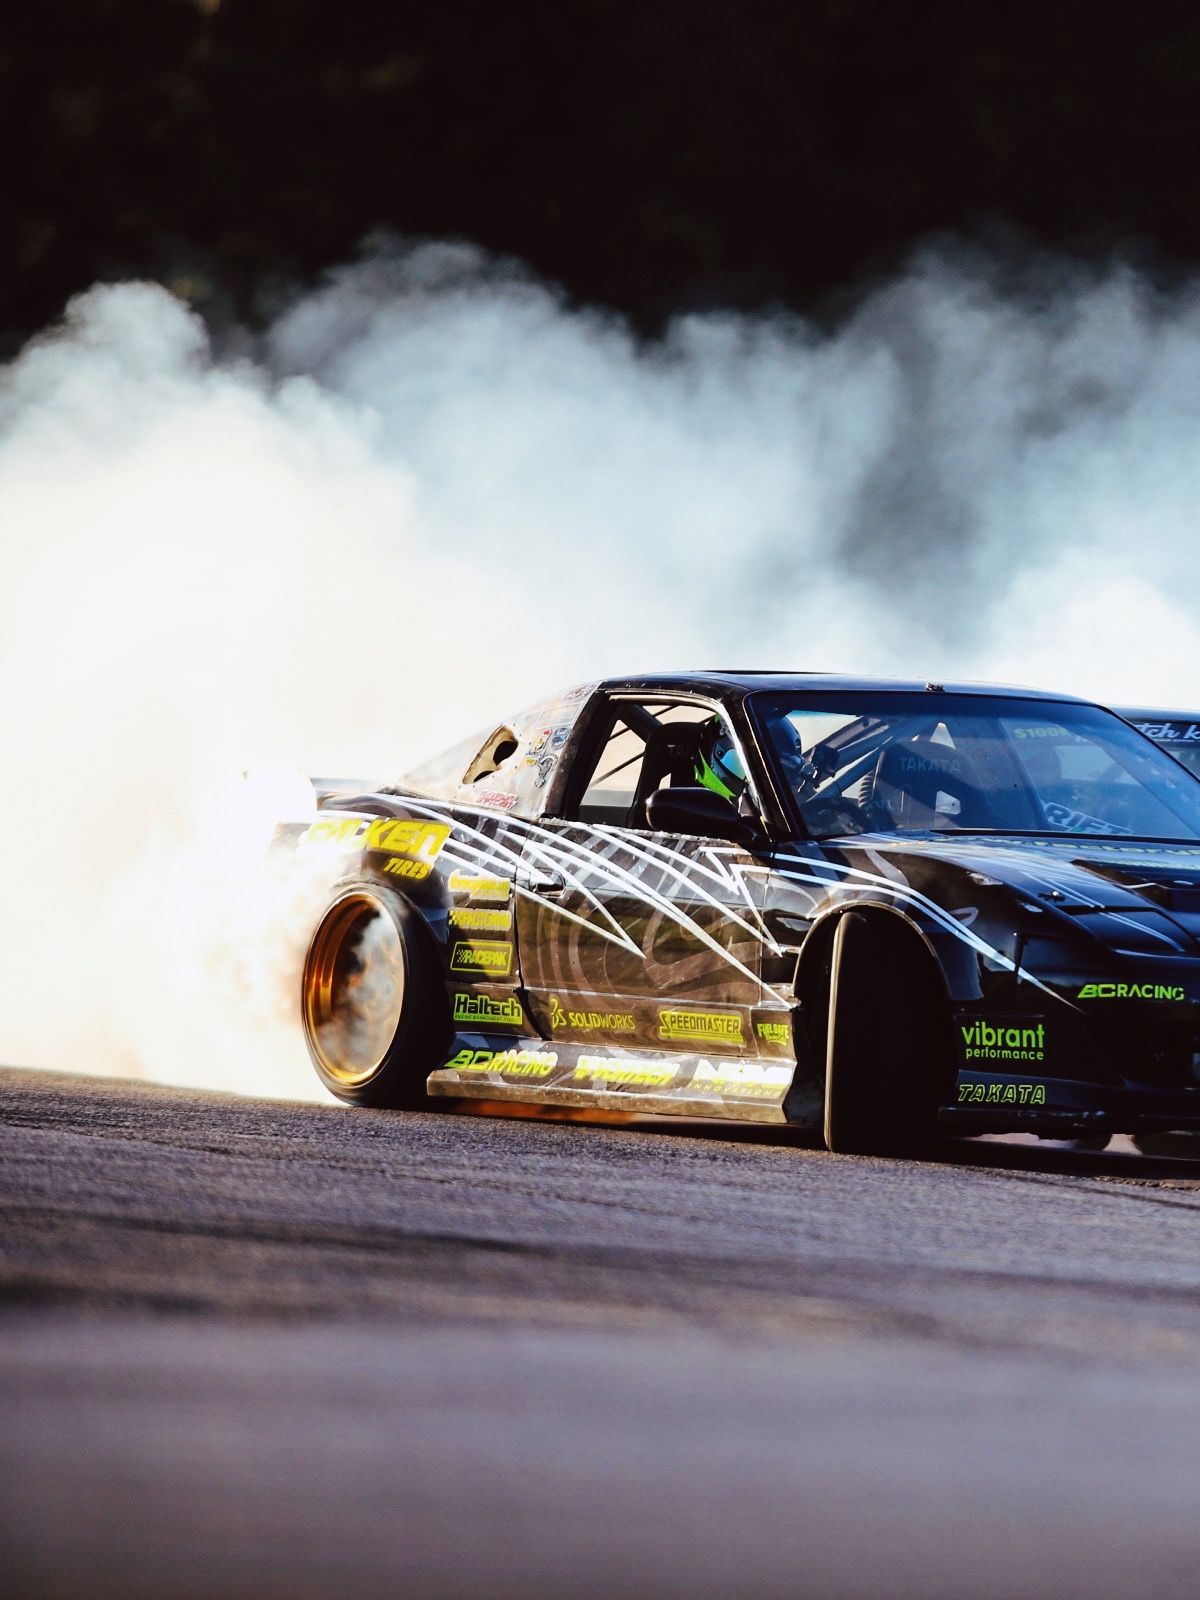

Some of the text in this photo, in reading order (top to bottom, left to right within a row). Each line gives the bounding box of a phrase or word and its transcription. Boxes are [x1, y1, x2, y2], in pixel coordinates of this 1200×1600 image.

[899, 757, 961, 772] TAKATA
[384, 857, 431, 881] TIRES
[462, 949, 508, 966] RACEPAK
[454, 993, 522, 1017] Haltech
[568, 1012, 636, 1030] SOLIDWORKS
[659, 1011, 742, 1034] SPEEDMASTER
[961, 1022, 1045, 1048] vibrant
[965, 1047, 1044, 1061] performance
[686, 1082, 782, 1098] INNOVATIONS
[958, 1084, 1046, 1104] TAKATA
